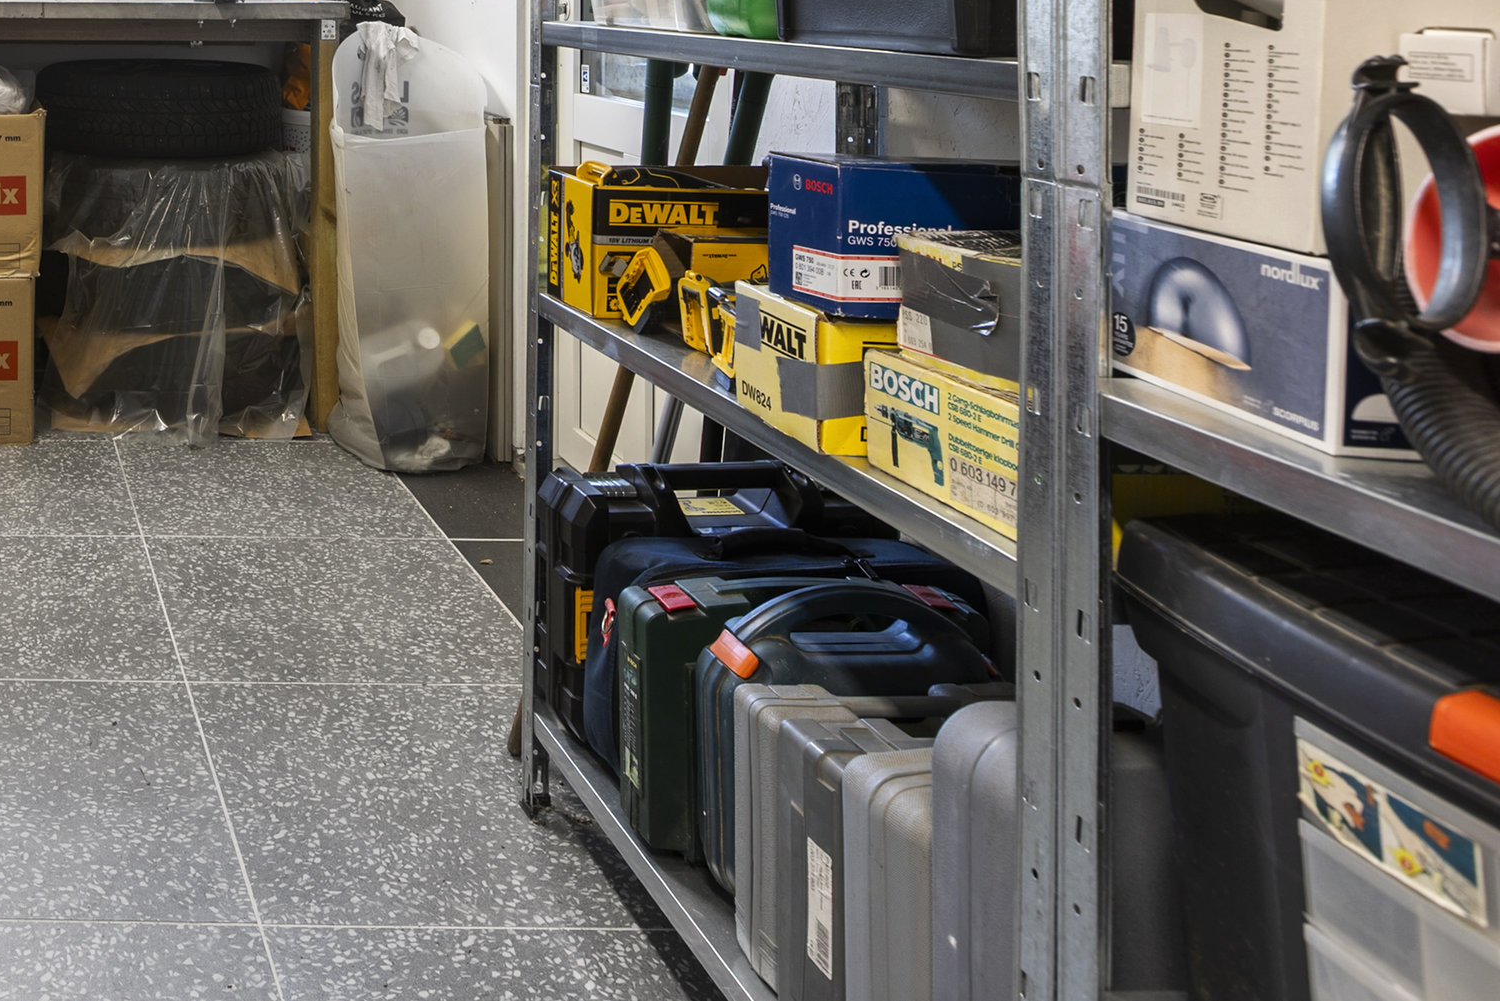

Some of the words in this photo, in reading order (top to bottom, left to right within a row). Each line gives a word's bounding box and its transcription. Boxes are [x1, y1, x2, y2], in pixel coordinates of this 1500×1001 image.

[805, 178, 833, 195] BOSCH
[621, 237, 650, 245] LITHIUM
[847, 235, 874, 246] GWS
[877, 236, 898, 248] 750
[1260, 259, 1320, 291] nordlux
[761, 315, 806, 360] WALT
[1113, 314, 1128, 333] 15
[742, 380, 772, 411] DW824
[870, 362, 939, 414] BOSCH
[953, 415, 972, 429] Speed
[972, 423, 1000, 441] Hammer
[950, 457, 958, 472] 0
[961, 462, 983, 483] 603
[986, 473, 1006, 492] 149
